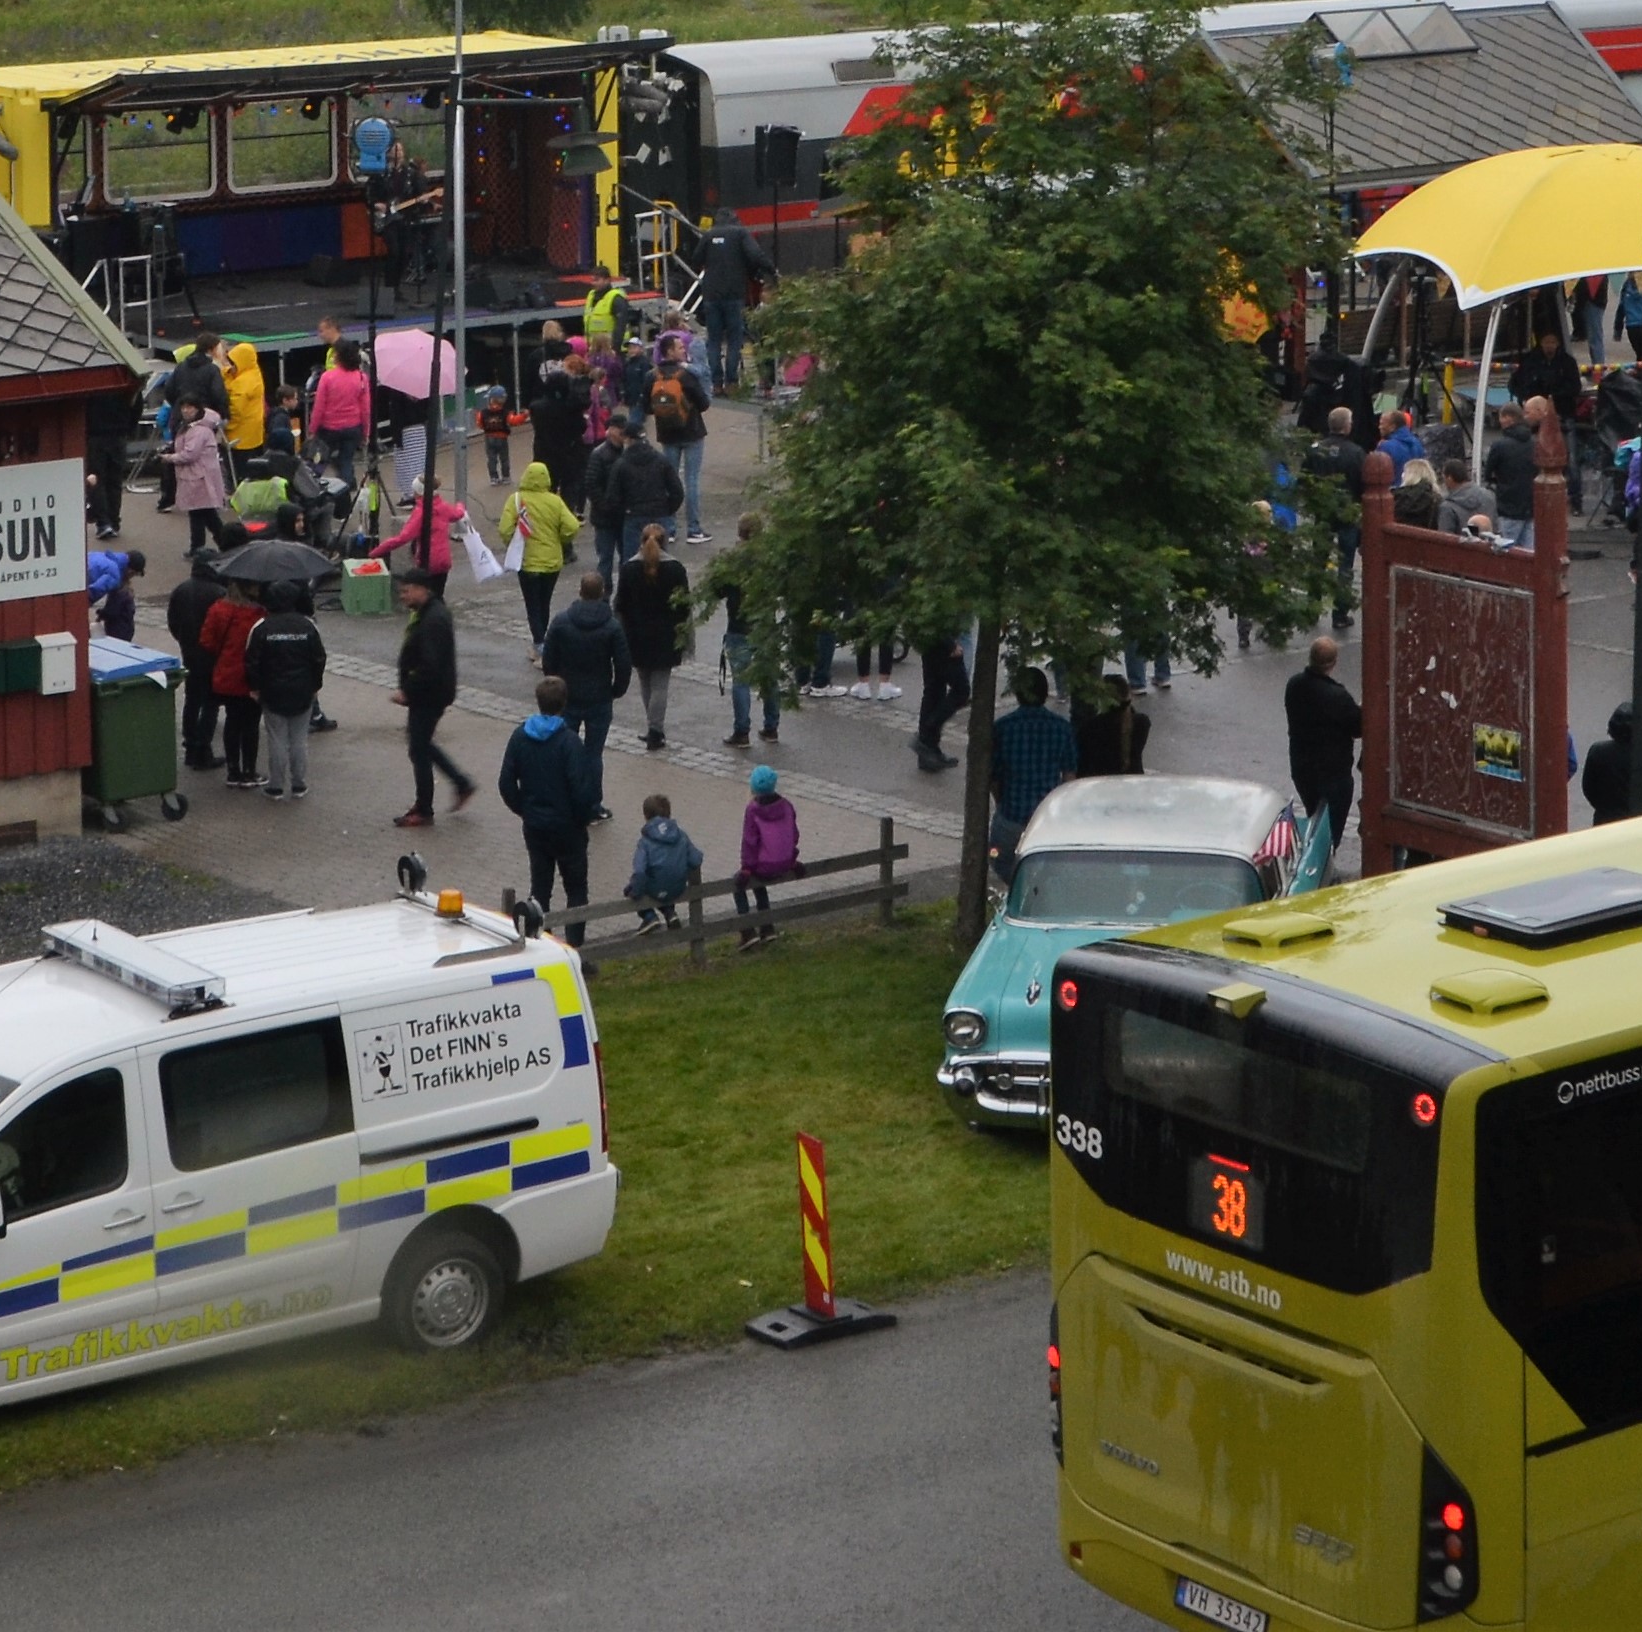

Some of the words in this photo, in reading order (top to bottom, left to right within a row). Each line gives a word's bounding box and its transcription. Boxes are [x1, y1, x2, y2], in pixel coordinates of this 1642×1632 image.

[0, 571, 31, 583] ÅPENT
[406, 1002, 522, 1038] Trafikkvakta
[410, 1046, 443, 1066] Det
[412, 1054, 520, 1091] Trafikkhjelp
[525, 1047, 551, 1069] AS
[1056, 1114, 1103, 1159] 338
[1213, 1174, 1246, 1237] 38
[1165, 1249, 1282, 1311] www.atb.no
[1187, 1584, 1209, 1612] VH
[1215, 1597, 1262, 1632] 35342
